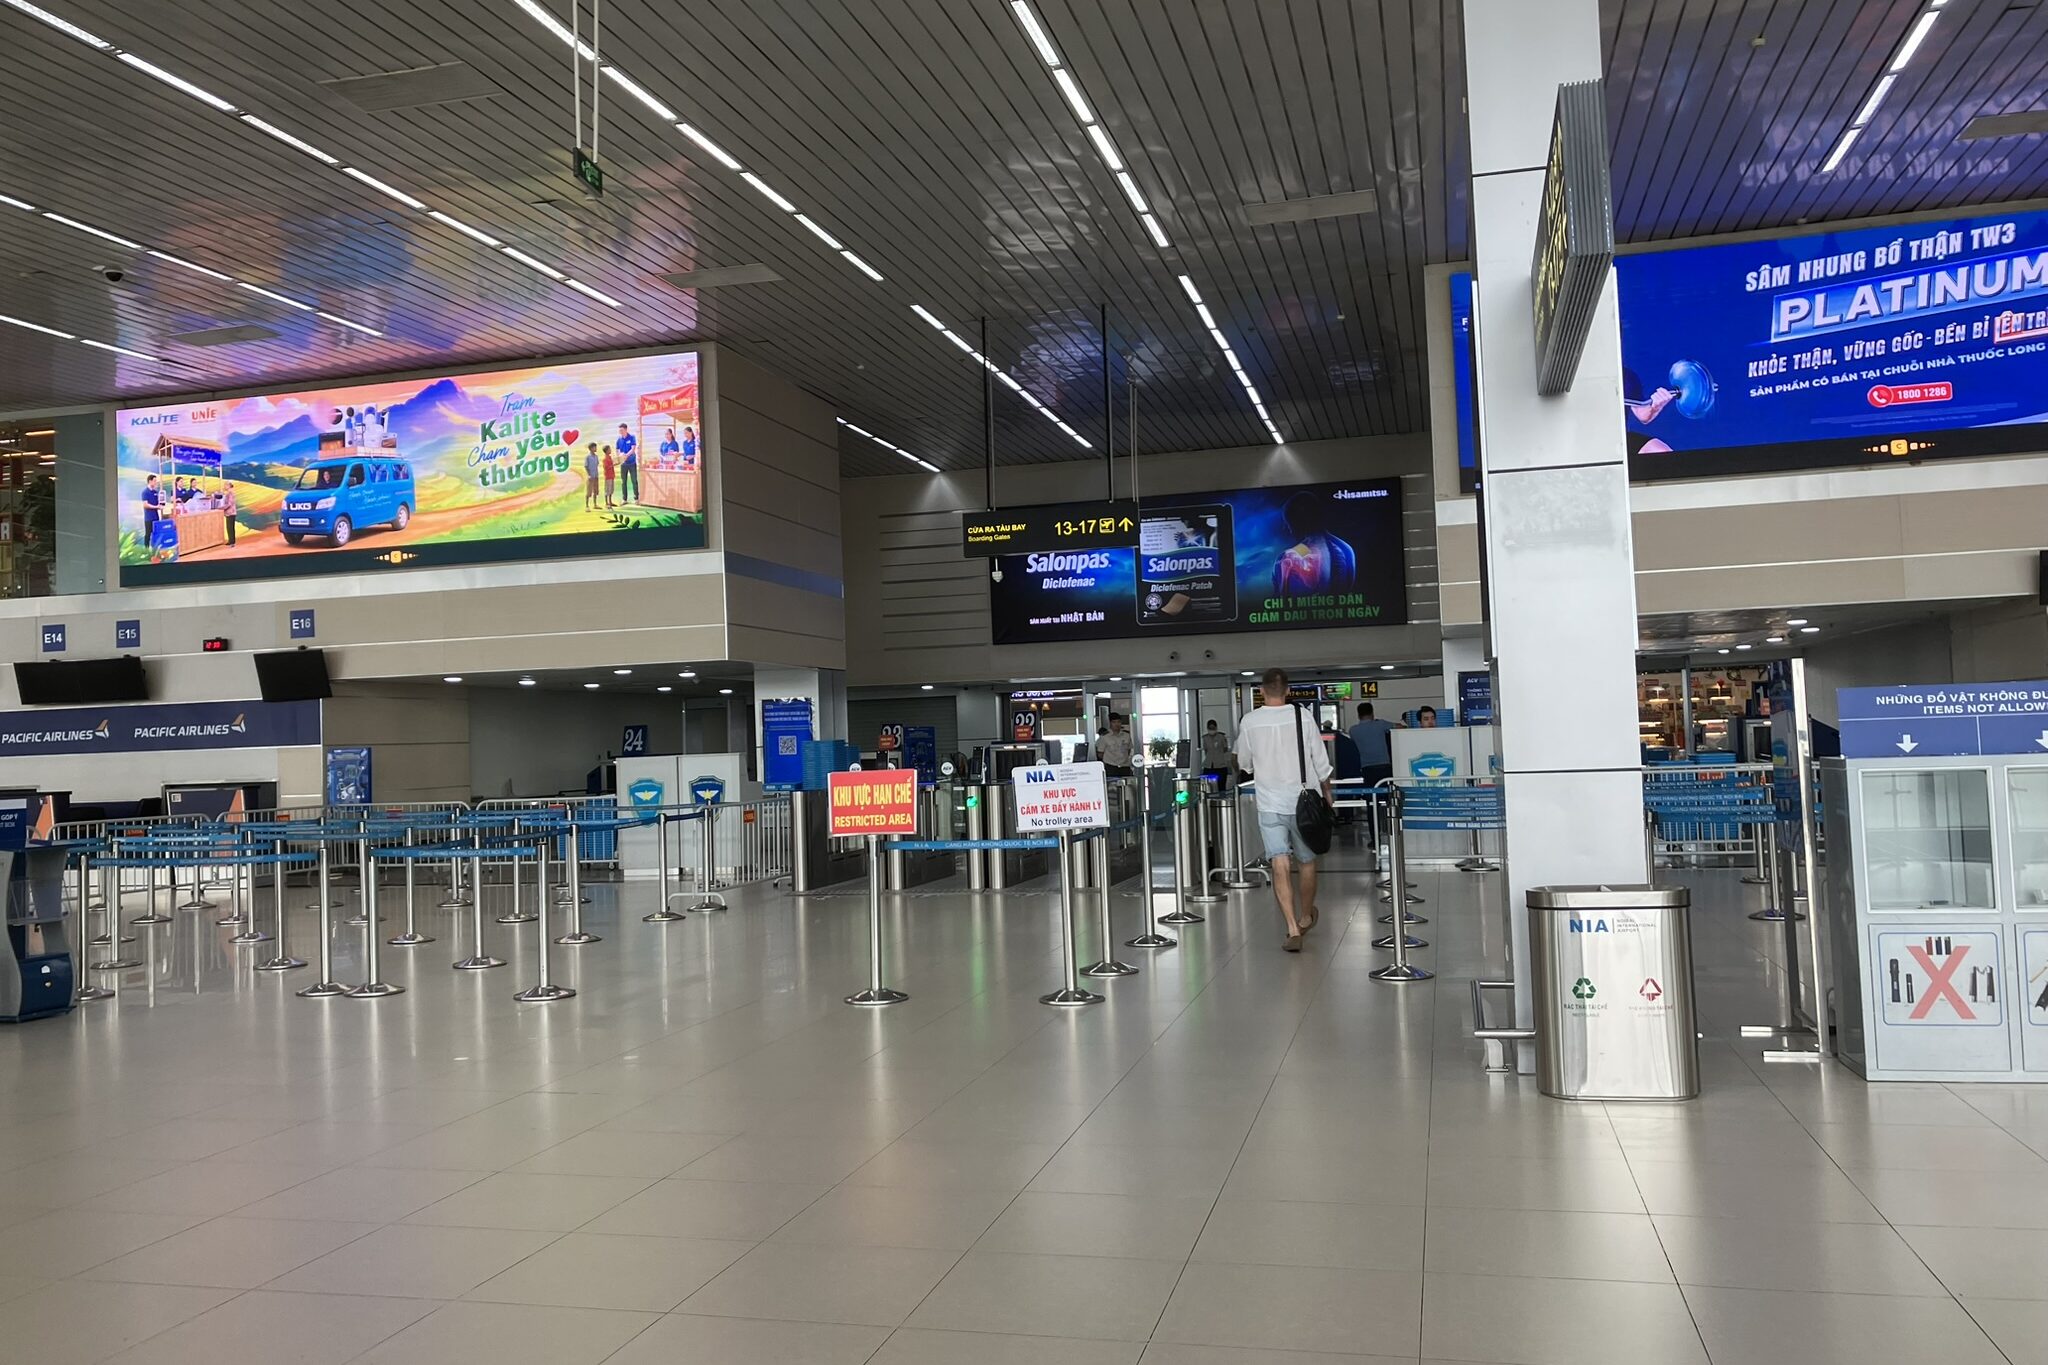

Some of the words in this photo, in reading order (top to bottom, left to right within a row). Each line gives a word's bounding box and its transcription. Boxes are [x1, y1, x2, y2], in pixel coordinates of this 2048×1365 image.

[1746, 264, 1790, 291] SÂM
[1799, 251, 1866, 283] NHUNG
[1875, 238, 1902, 268] BỔ
[1910, 230, 1963, 262] THẬN
[1971, 223, 2015, 249] TW3
[1778, 251, 2048, 334] PLATINUM
[1748, 354, 1787, 378] KHỎE
[1793, 347, 1837, 369] THẬN,
[1844, 339, 1886, 361] VỮNG
[1892, 330, 1923, 353] GỐC
[1934, 322, 1966, 346] BỀN
[1750, 385, 1773, 397] SẢN
[1776, 380, 1809, 392] PHẨM
[1812, 376, 1829, 387] CÓ
[1832, 373, 1857, 384] BÁN
[1860, 369, 1880, 380] TẠI
[1883, 359, 1923, 375] CHUỖI
[1926, 356, 1956, 369] NHÀ
[1958, 348, 2005, 363] THUỐC
[2008, 342, 2046, 356] LONG
[1897, 389, 1921, 400] 1800
[1923, 386, 1947, 398] 1286
[480, 411, 557, 443] Kalite
[515, 430, 560, 460] yêu
[479, 451, 570, 487] thương
[968, 526, 984, 534] CỬA
[1054, 520, 1097, 535] 13-17
[1026, 552, 1109, 574] Salonpas
[1148, 557, 1213, 573] Salonpas
[1042, 577, 1096, 590] Diclofenac
[1151, 583, 1189, 592] Diclofenac
[1191, 581, 1212, 590] Patch
[1288, 598, 1293, 608] 1
[292, 618, 311, 629] E16
[1061, 611, 1084, 623] NHẬT
[1086, 610, 1104, 621] BẢN
[44, 633, 63, 644] E14
[118, 629, 137, 640] E15
[1362, 683, 1377, 694] 14
[1876, 694, 1923, 705] NHỮNG
[1927, 691, 1947, 703] ĐỒ
[1949, 692, 1975, 704] VẬT
[1979, 690, 2028, 702] KHÔNG
[1924, 705, 1963, 714] ITEMS
[1967, 704, 1994, 713] NOT
[1999, 702, 2048, 712] ALLOW
[1, 733, 42, 744] PACIFIC
[43, 730, 94, 742] AIRLINES
[134, 726, 177, 738] PACIFIC
[177, 724, 230, 736] AIRLINES
[624, 728, 643, 752] 24
[1026, 770, 1055, 783] NIA
[833, 785, 851, 807] KHU
[853, 783, 871, 810] VỰC
[873, 784, 892, 809] HẠN
[894, 776, 912, 804] CHẾ
[1043, 789, 1059, 799] KHU
[1040, 804, 1050, 813] XE
[834, 814, 886, 827] RESTRICTED
[888, 813, 912, 825] AREA
[1031, 818, 1043, 827] No
[1045, 817, 1072, 826] trolley
[1570, 919, 1609, 933] NIA
